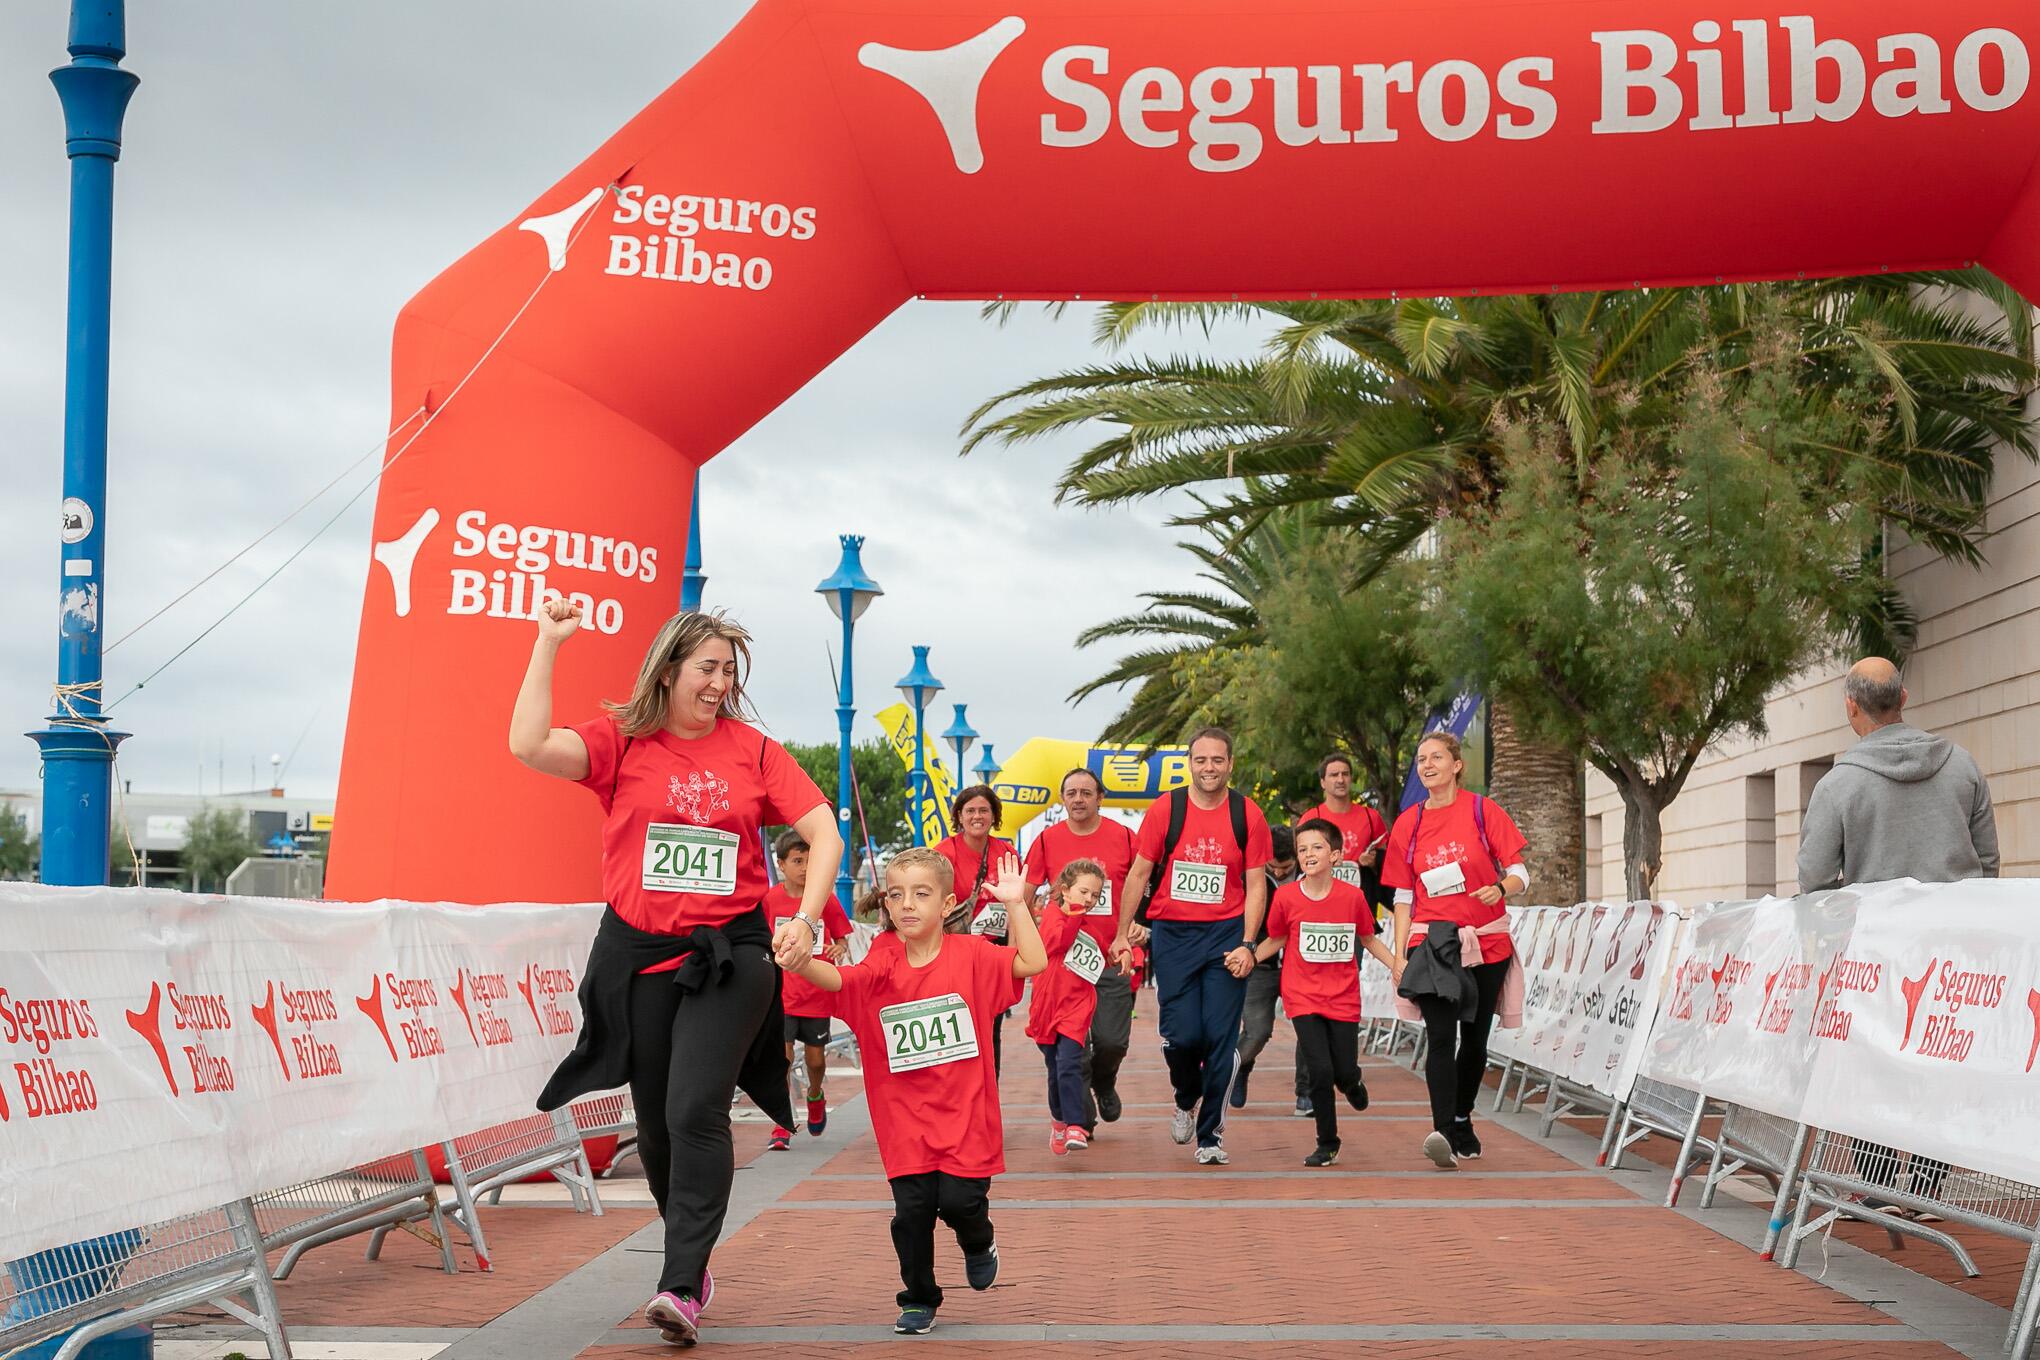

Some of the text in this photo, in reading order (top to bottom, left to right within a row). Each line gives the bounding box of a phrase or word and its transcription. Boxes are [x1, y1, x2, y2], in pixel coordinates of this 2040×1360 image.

[1041, 15, 2030, 172] Seguros Bilbao
[612, 185, 817, 240] Seguros
[604, 234, 773, 290] Bilbao
[452, 510, 658, 583] Seguros
[1017, 787, 1048, 803] BM
[653, 842, 724, 878] 2041
[1177, 872, 1220, 894] 2036
[1071, 942, 1102, 972] 036
[1306, 934, 1349, 953] 2036
[167, 982, 232, 1040] Seguros
[280, 980, 338, 1031] Seguros
[466, 968, 508, 1008] Seguros
[1934, 960, 2006, 1013] Seguros
[0, 986, 99, 1054] Seguros
[477, 1010, 513, 1046] Bilbao
[892, 1012, 961, 1055] 2041
[1916, 1014, 1975, 1063] Bilbao
[183, 1043, 234, 1094] Bilbao
[292, 1033, 343, 1079] Bilbao
[14, 1058, 98, 1118] Bilbao
